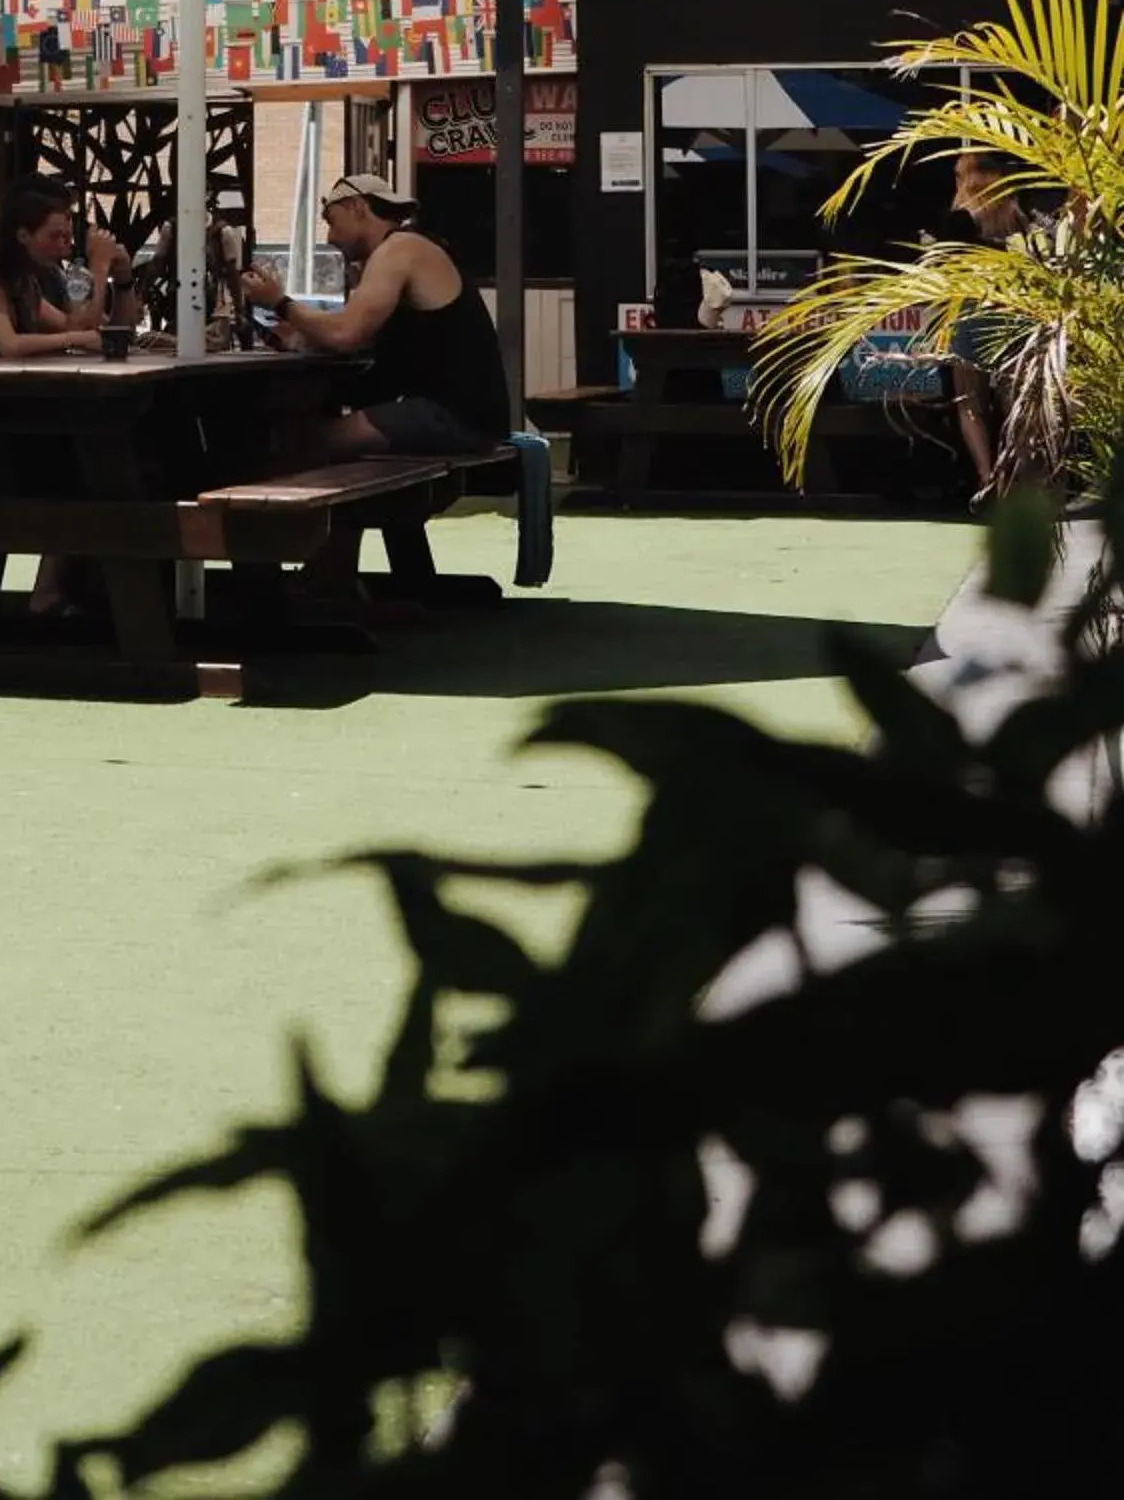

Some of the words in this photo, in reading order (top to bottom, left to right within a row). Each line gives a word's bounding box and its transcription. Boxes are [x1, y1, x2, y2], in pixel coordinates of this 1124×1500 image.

[422, 83, 496, 128] CLU
[531, 82, 578, 110] WA
[429, 124, 496, 155] CRA
